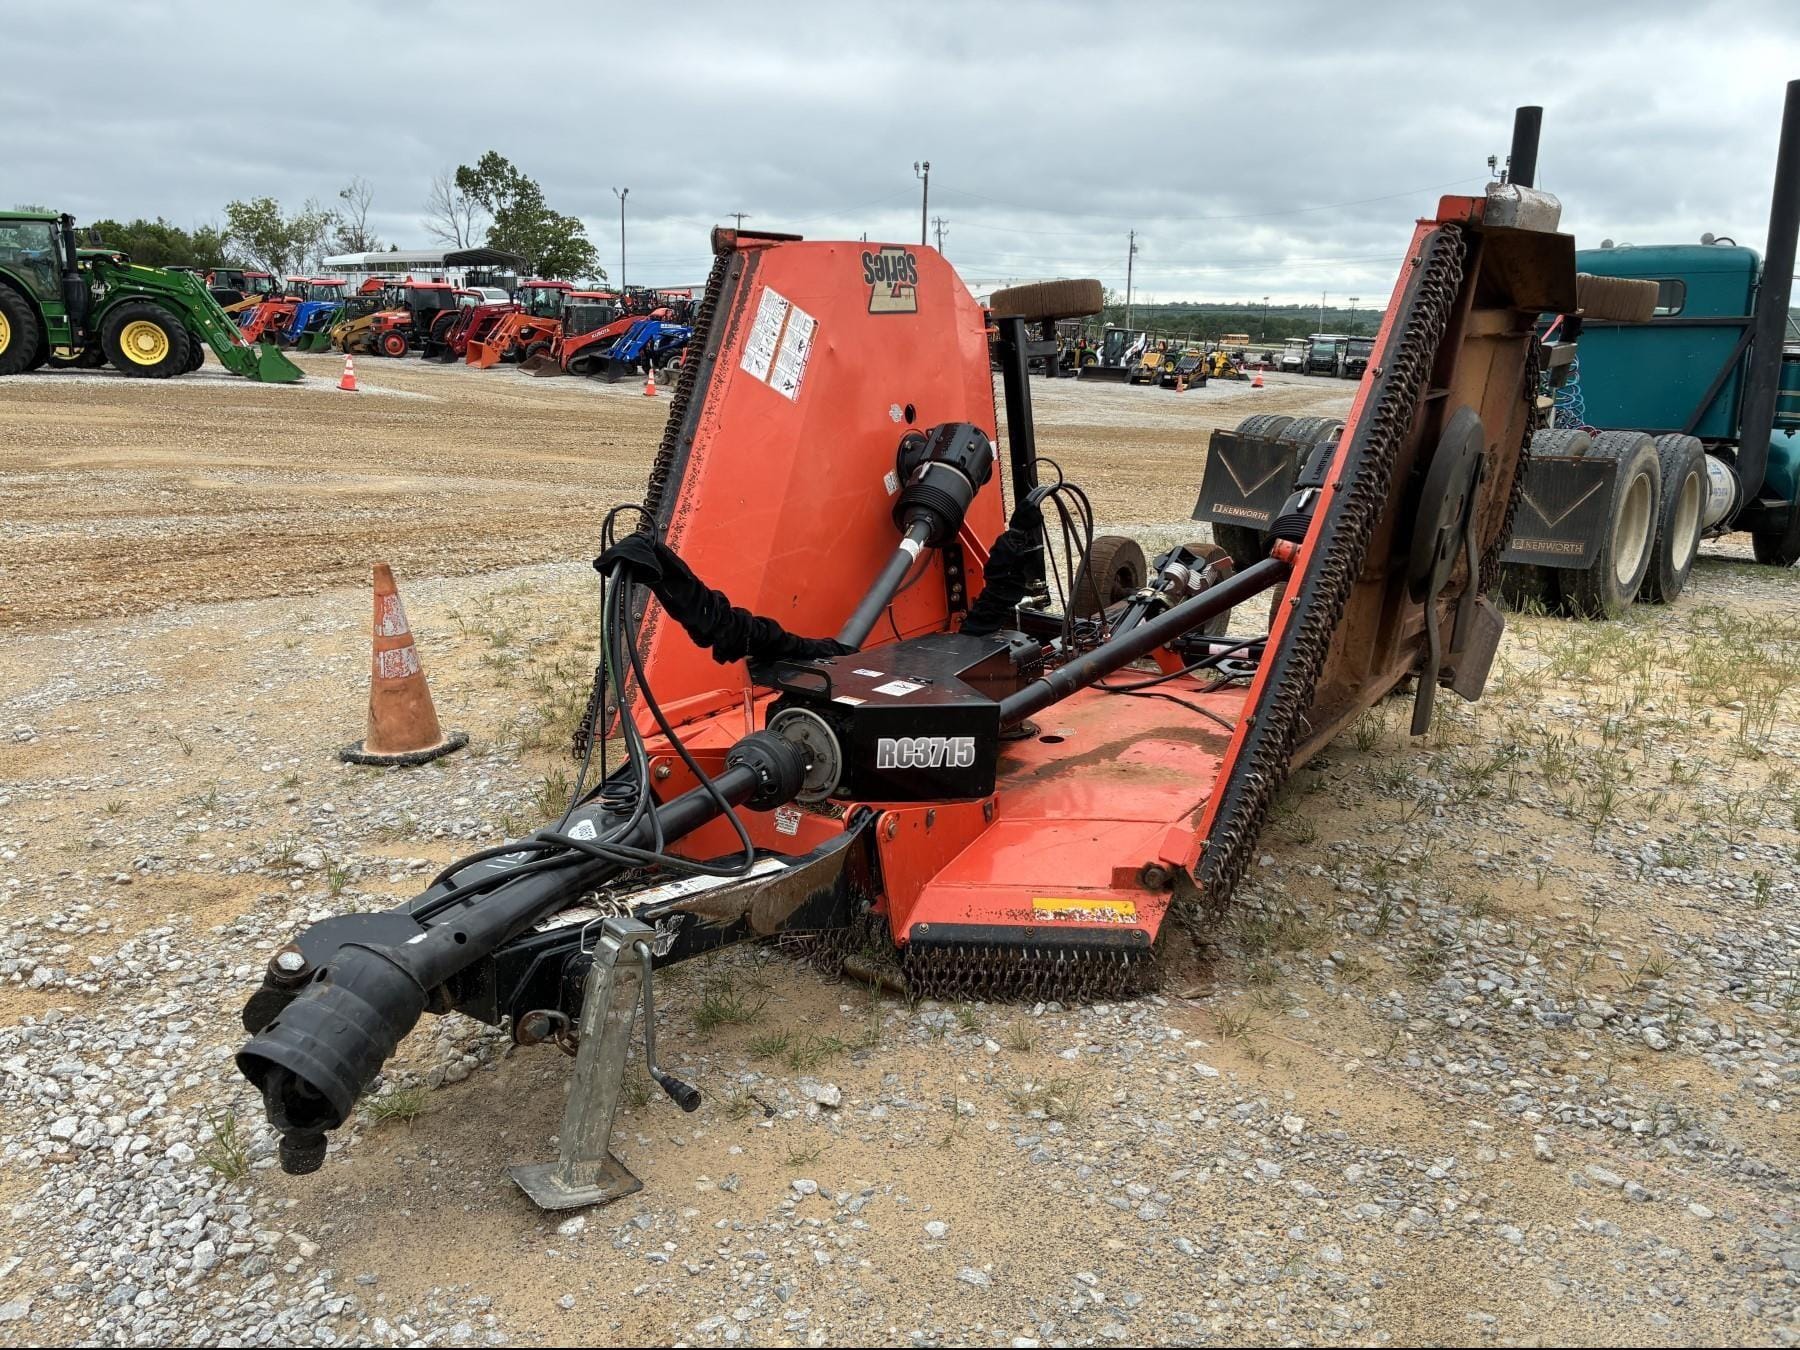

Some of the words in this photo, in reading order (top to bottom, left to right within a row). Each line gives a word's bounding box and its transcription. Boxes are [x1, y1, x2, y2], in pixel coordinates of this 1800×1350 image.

[862, 250, 918, 289] series
[591, 328, 610, 339] KUBOTA
[1222, 505, 1269, 521] KENWORTH
[1525, 541, 1582, 553] KENWORTH
[877, 737, 975, 768] RC3715
